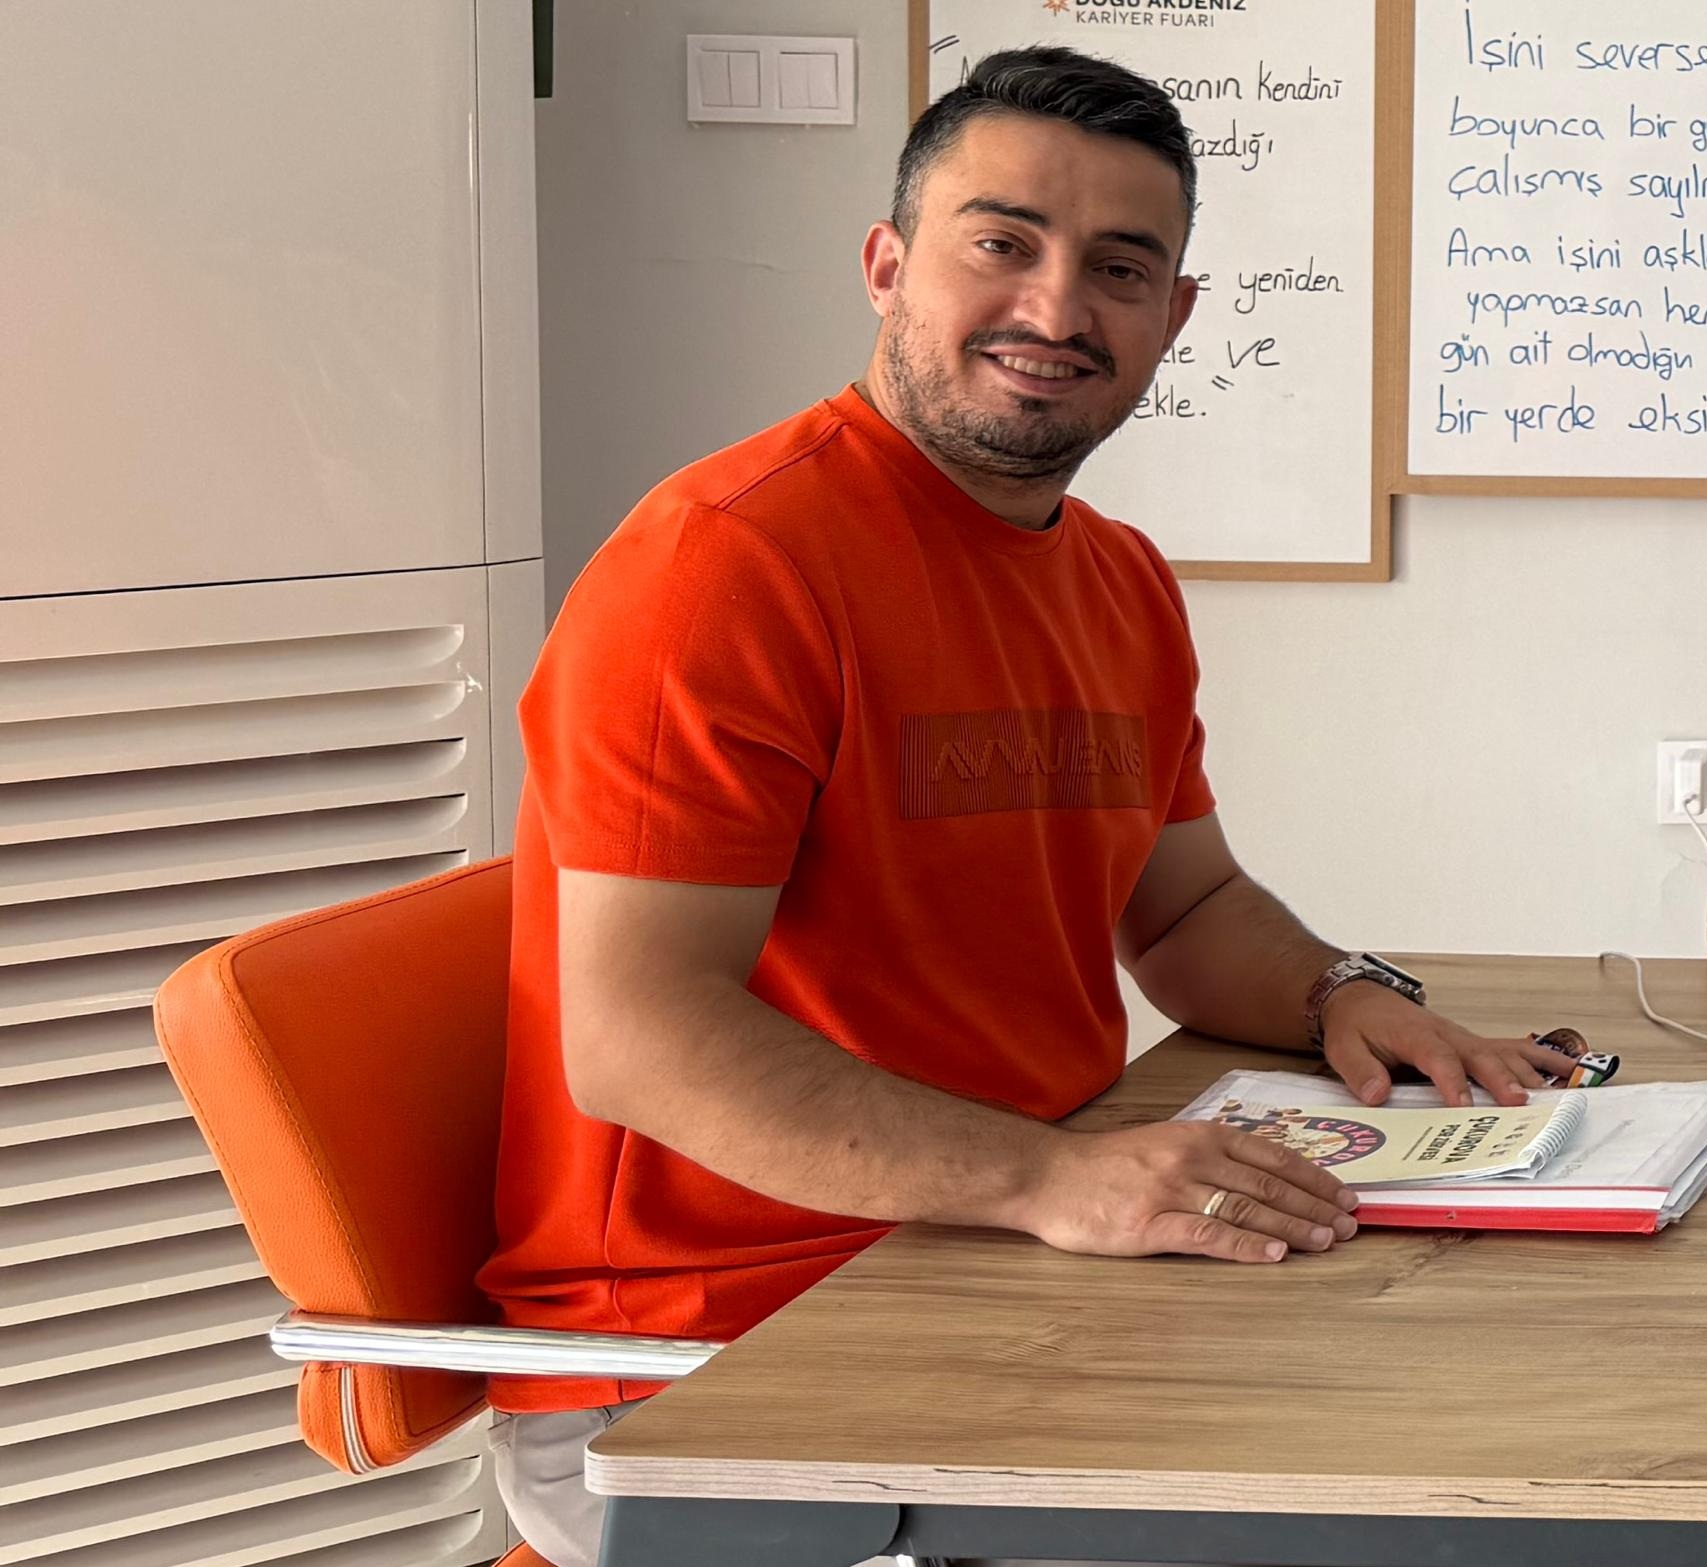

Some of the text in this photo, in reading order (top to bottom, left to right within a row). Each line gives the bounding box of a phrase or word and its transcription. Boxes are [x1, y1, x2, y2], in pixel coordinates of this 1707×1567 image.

[1447, 94, 1605, 151] boyunca
[1629, 103, 1678, 140] bir
[1447, 226, 1532, 268] Ama
[1557, 235, 1621, 273] işini
[1235, 256, 1343, 313] yeniden
[1466, 291, 1643, 329] yapmazsan
[1439, 332, 1490, 374] gün
[1509, 329, 1553, 366] ait
[1435, 383, 1489, 435] bir
[1504, 384, 1596, 444] yerde
